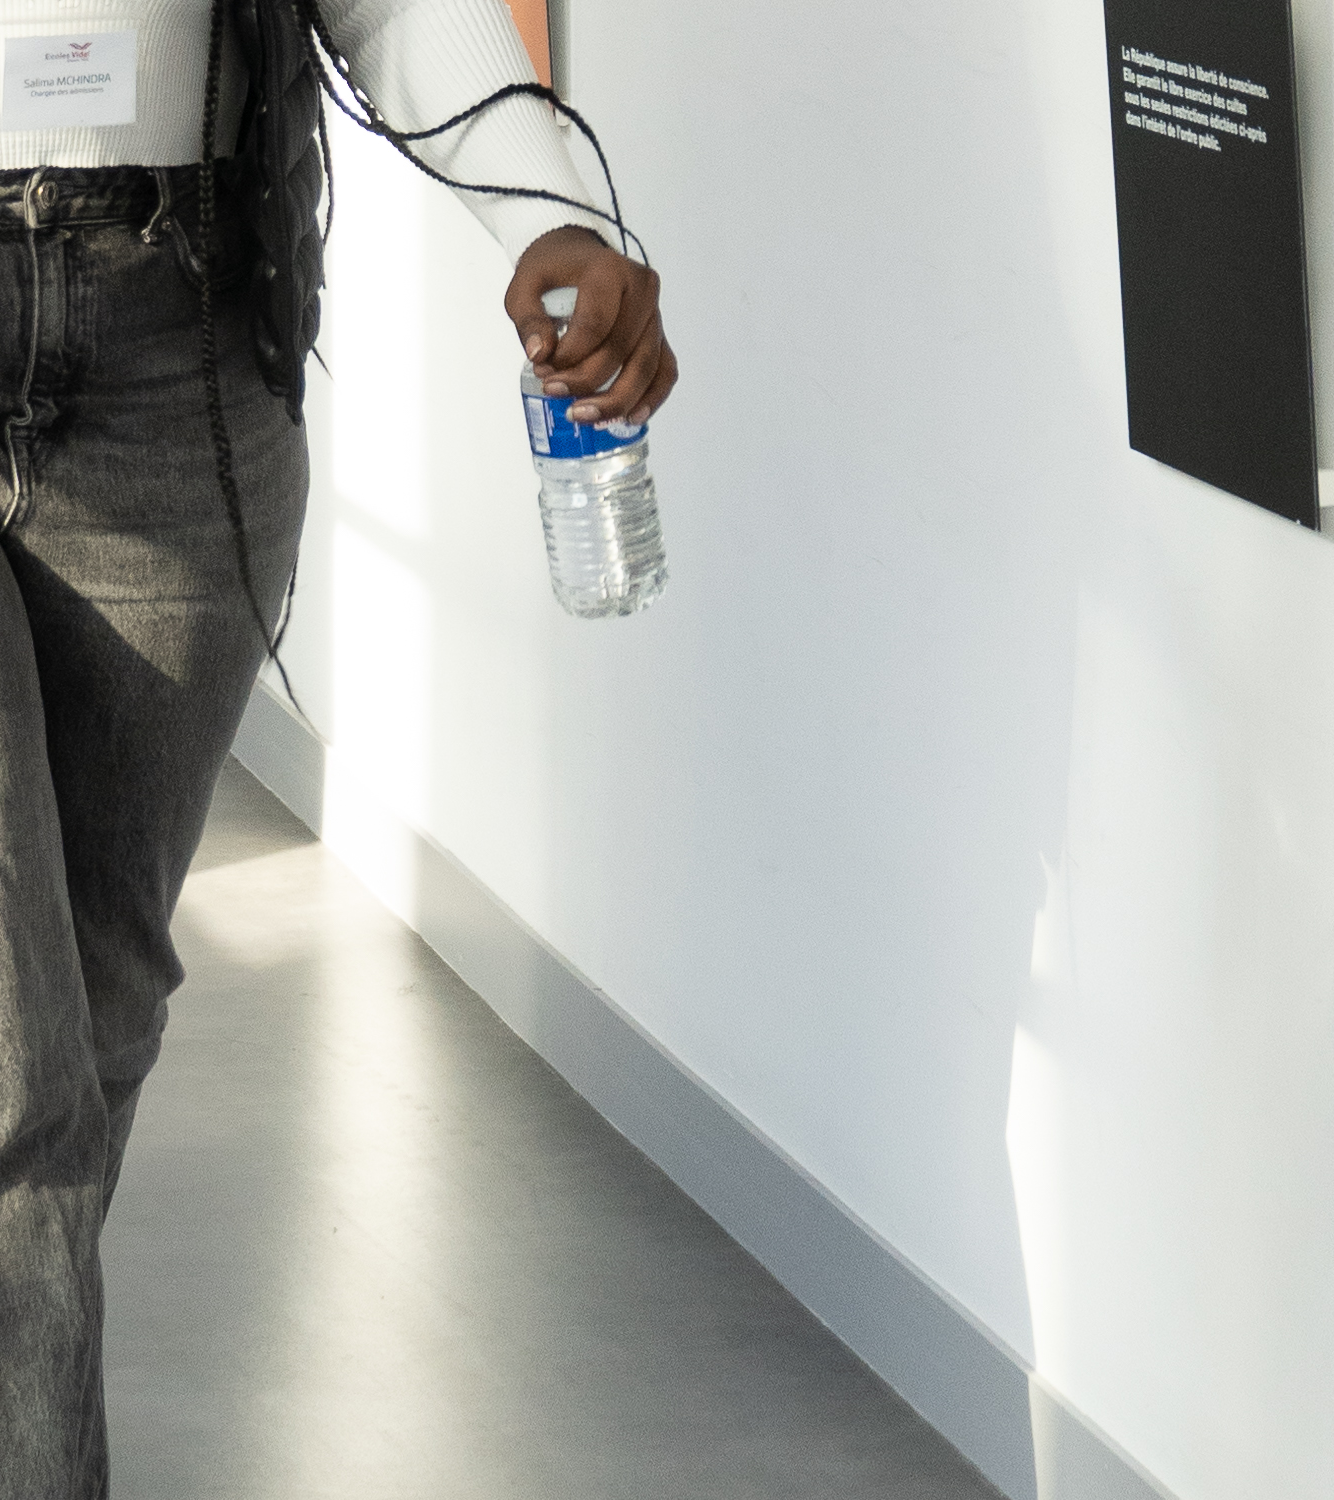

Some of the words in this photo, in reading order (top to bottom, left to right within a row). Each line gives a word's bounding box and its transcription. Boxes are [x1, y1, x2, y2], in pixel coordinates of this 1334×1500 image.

[24, 78, 55, 89] Salima
[56, 73, 112, 87] MCHINDRA
[1122, 45, 1131, 61] La
[1131, 47, 1166, 71] République
[1166, 60, 1188, 77] assure
[1188, 63, 1196, 79] la
[1196, 65, 1218, 85] liberté
[1218, 72, 1228, 88] de
[1228, 77, 1269, 99] conscience.
[1123, 66, 1136, 84] Elle
[1136, 73, 1161, 91] garantit
[1161, 77, 1169, 93] le
[1169, 79, 1184, 97] libre
[1184, 87, 1212, 105] exercice
[1212, 92, 1226, 109] des
[1226, 98, 1247, 115] cultes
[1125, 91, 1140, 106] sous
[1140, 92, 1151, 109] les
[1151, 98, 1172, 115] seules
[1172, 105, 1209, 126] restrictions
[1209, 113, 1239, 135] édictées
[1239, 122, 1267, 143] ci-après
[1126, 110, 1142, 127] dans
[1142, 114, 1167, 135] l'intérêt
[1167, 122, 1176, 138] de
[1176, 124, 1198, 145] l'ordre
[1198, 133, 1221, 151] public.
